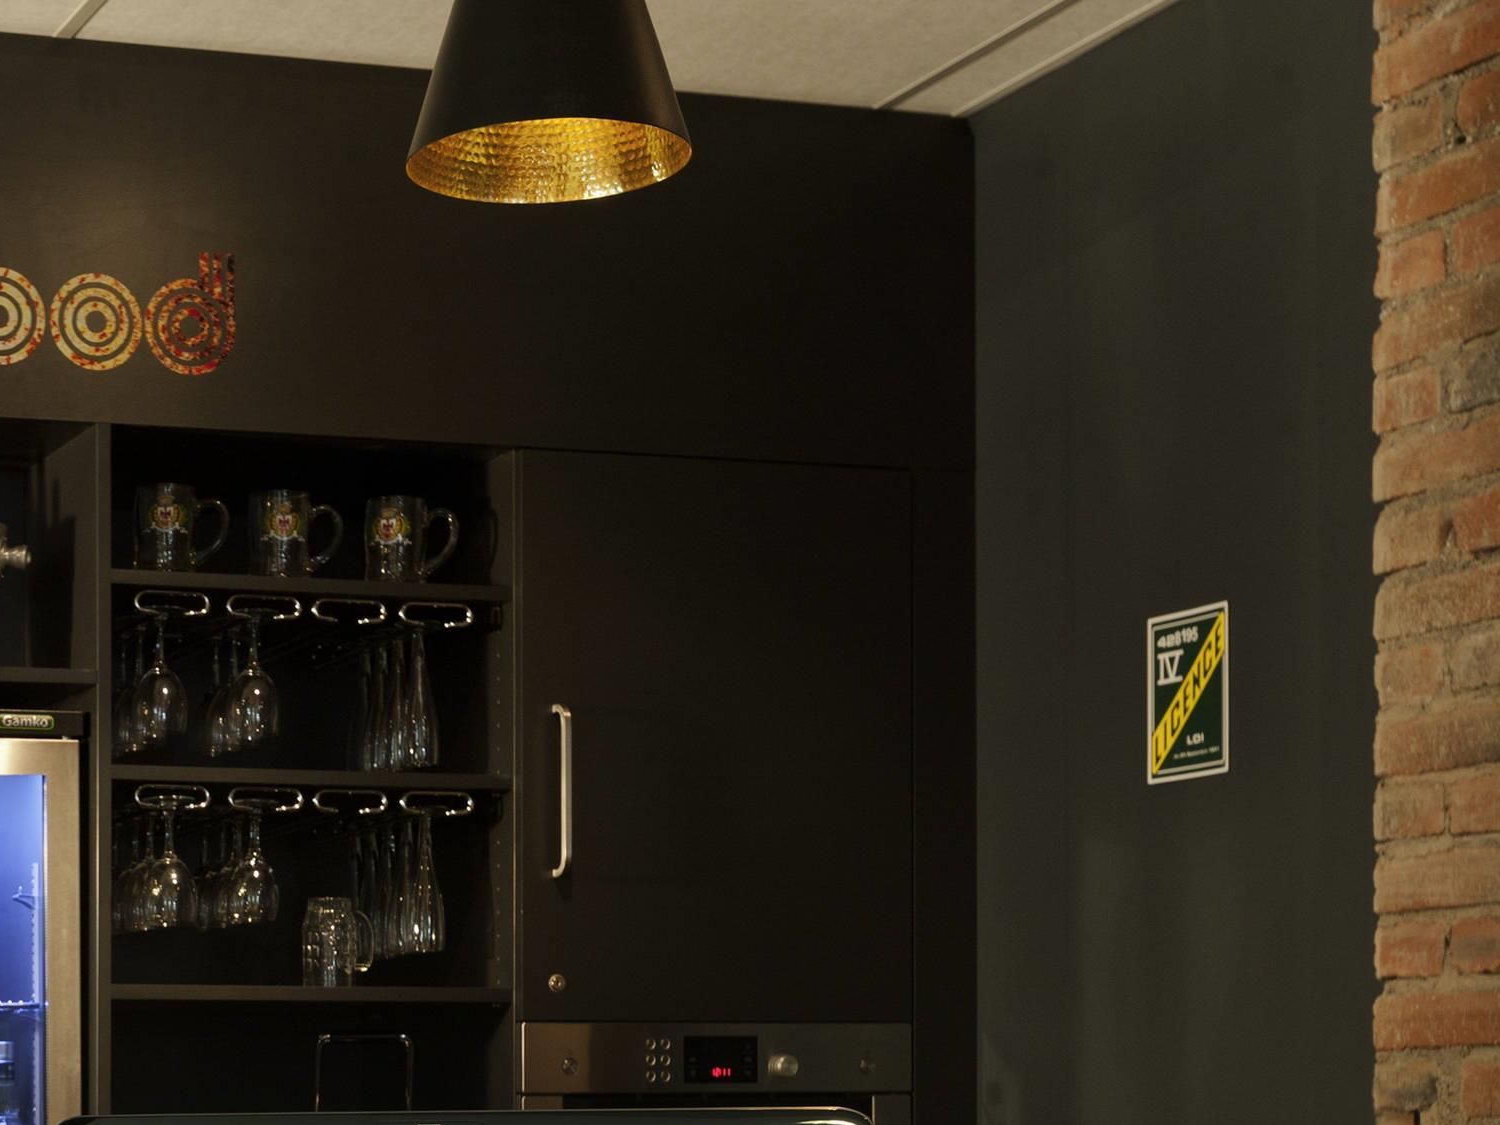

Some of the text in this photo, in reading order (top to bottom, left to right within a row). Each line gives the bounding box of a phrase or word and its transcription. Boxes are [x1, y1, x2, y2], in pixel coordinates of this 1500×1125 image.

[1157, 648, 1184, 685] IV
[1154, 622, 1224, 762] LICENCE
[2, 714, 49, 727] Gamko
